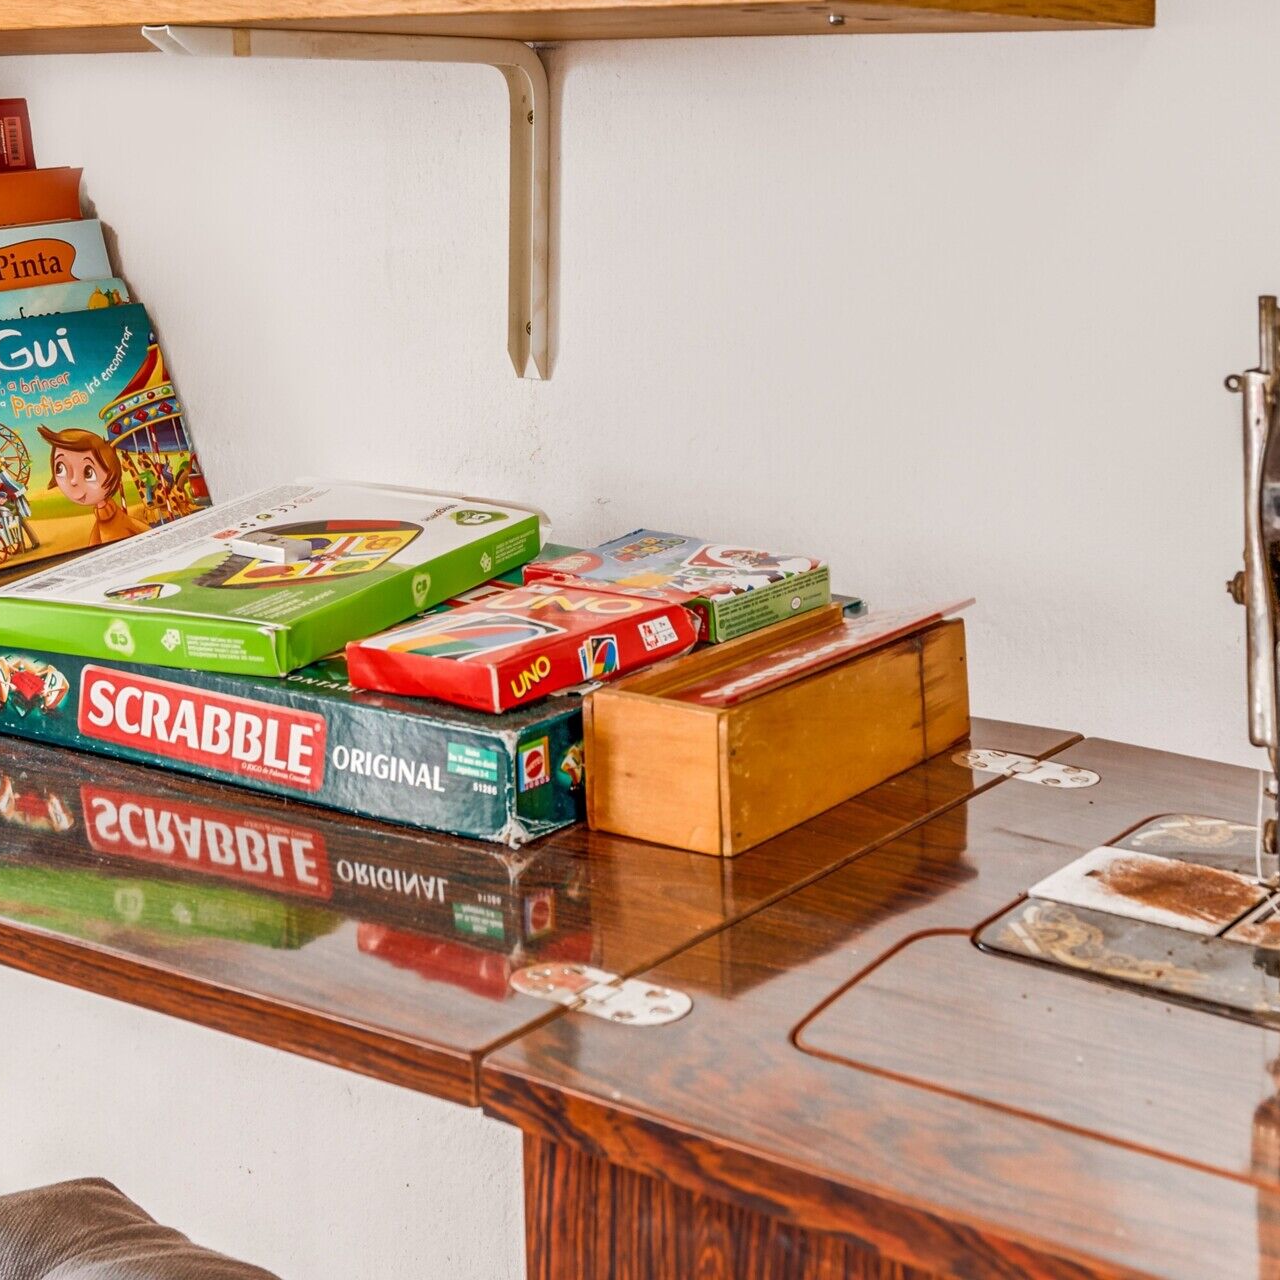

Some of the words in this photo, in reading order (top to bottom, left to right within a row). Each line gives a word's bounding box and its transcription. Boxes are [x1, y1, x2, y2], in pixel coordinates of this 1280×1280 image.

[8, 380, 18, 392] a
[19, 371, 71, 394] brincar
[10, 389, 90, 419] Profissão
[101, 325, 134, 382] encontrar
[485, 591, 645, 615] UNO
[511, 655, 551, 699] UNO
[87, 679, 315, 777] SCRABBLE
[332, 744, 446, 793] ORIGINAL
